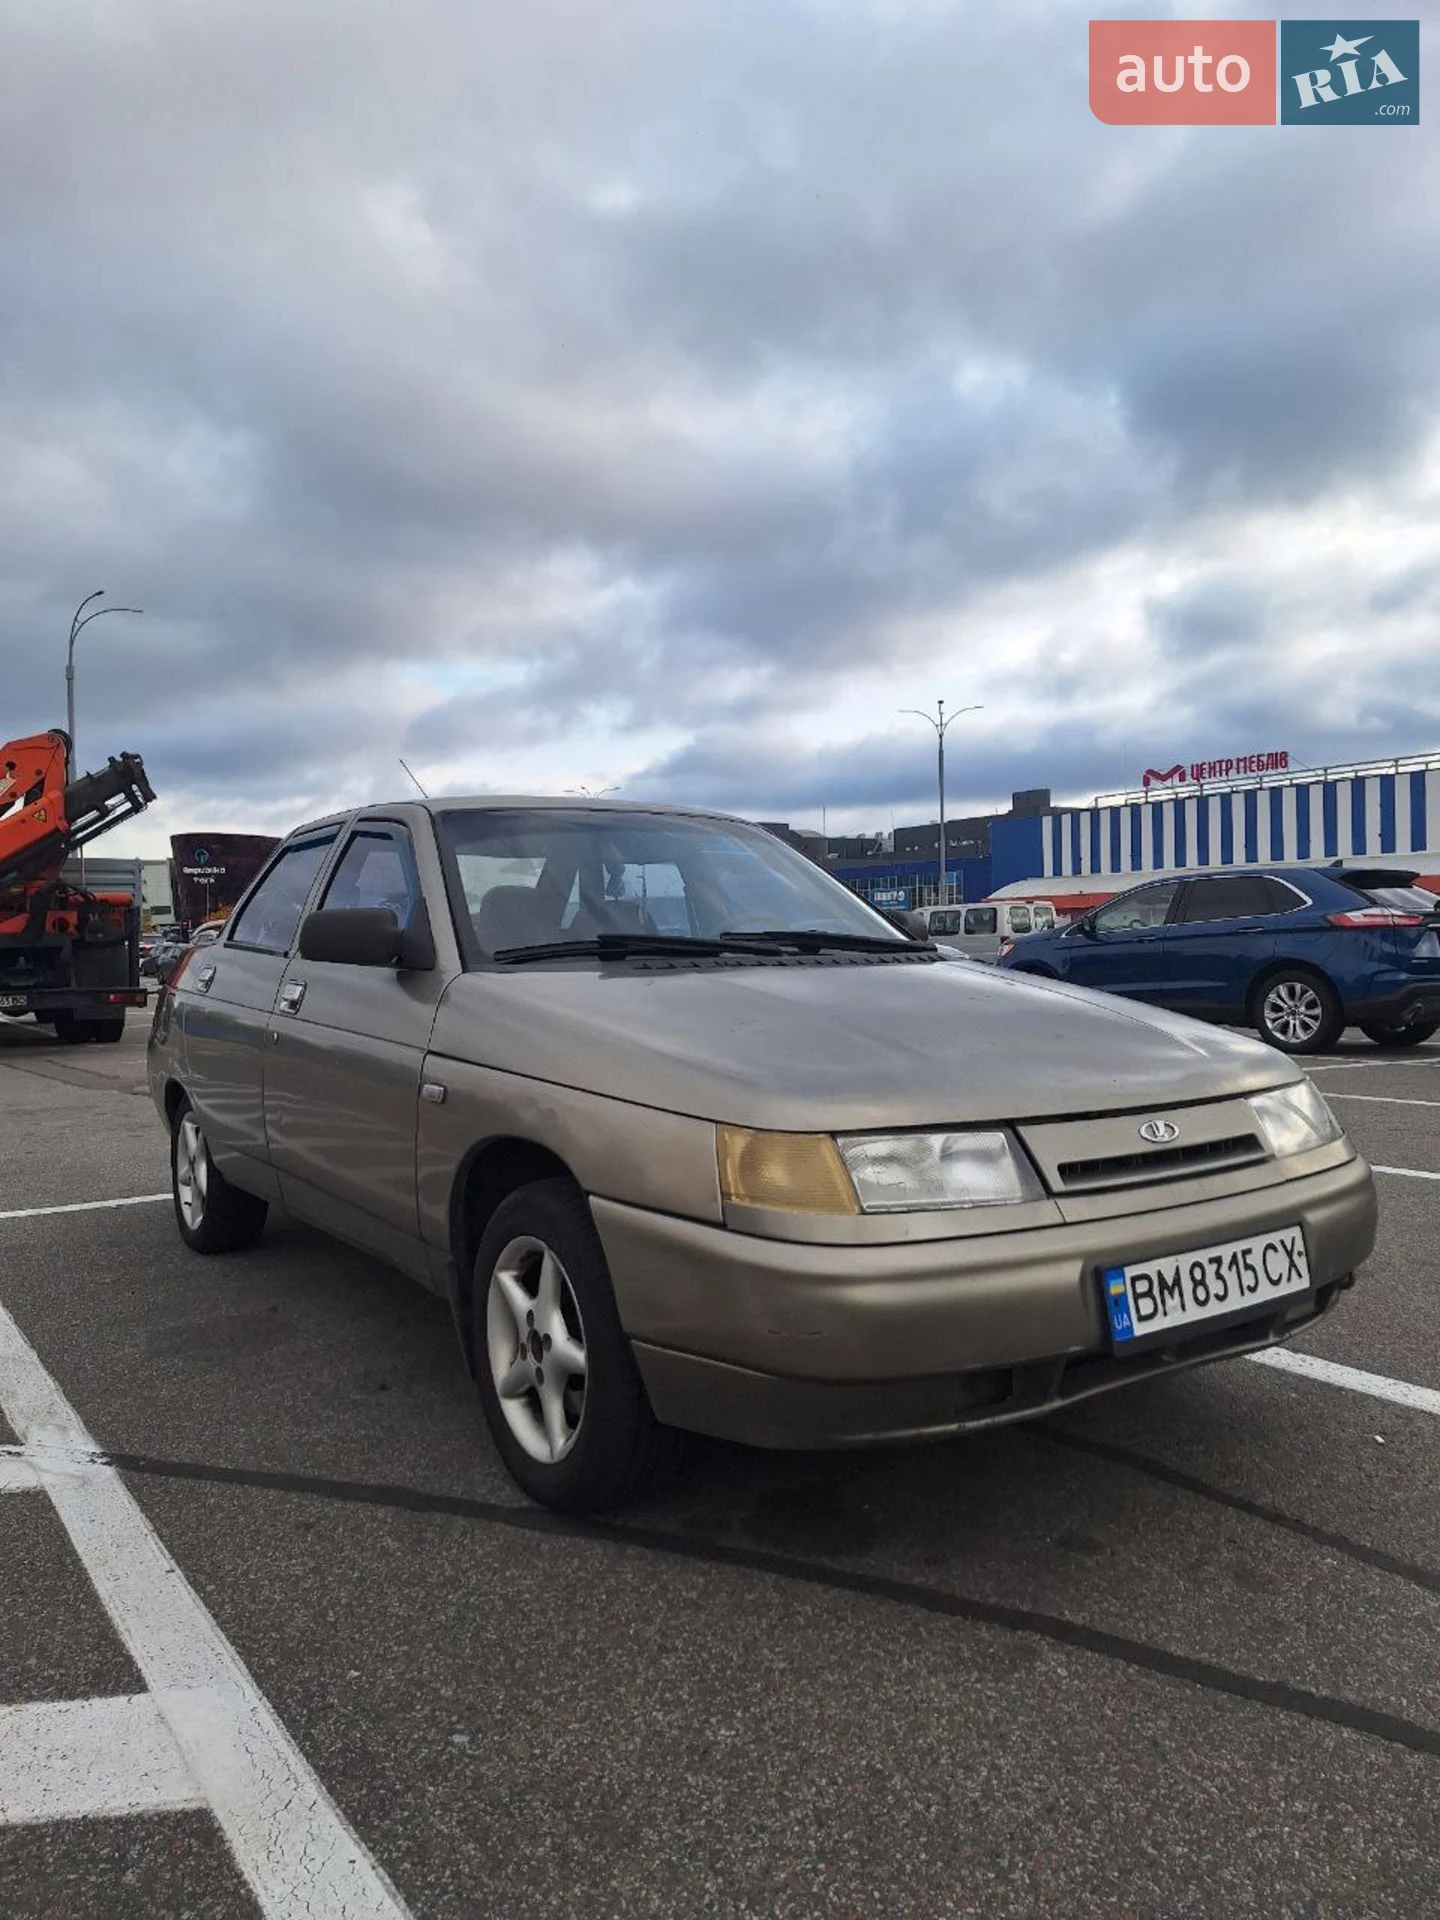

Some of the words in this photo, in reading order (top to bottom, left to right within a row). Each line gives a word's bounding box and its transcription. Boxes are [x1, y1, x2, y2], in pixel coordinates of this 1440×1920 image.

[1190, 759, 1234, 783] ЦЕНТР
[1237, 751, 1289, 775] МЕБЛІВ
[1114, 1316, 1131, 1330] UA
